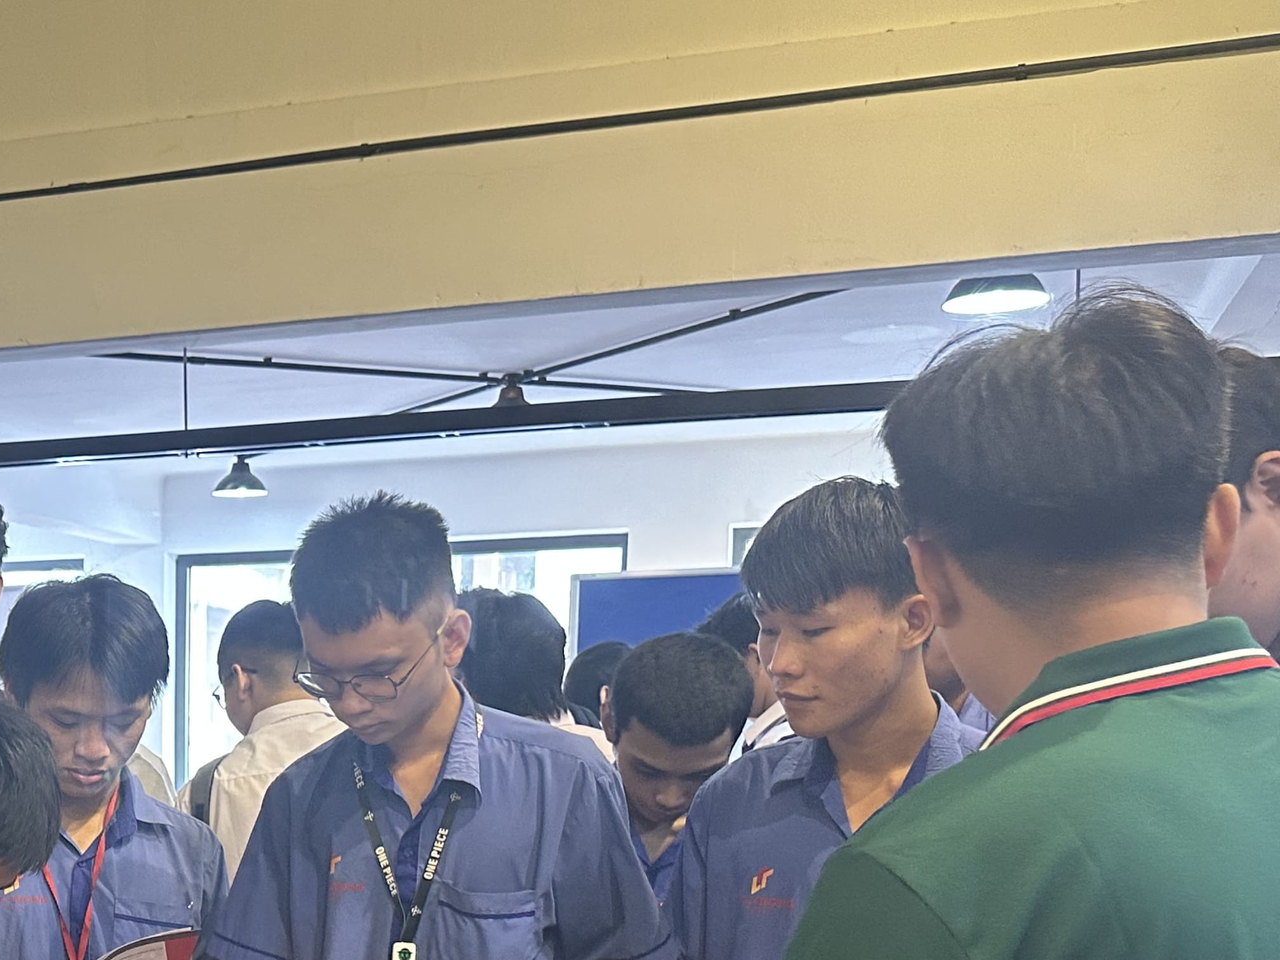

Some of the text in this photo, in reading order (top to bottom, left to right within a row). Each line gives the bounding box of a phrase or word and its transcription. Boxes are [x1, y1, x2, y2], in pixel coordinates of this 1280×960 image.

[375, 845, 398, 897] ONE PIECE
[423, 827, 449, 880] ONE PIECE
